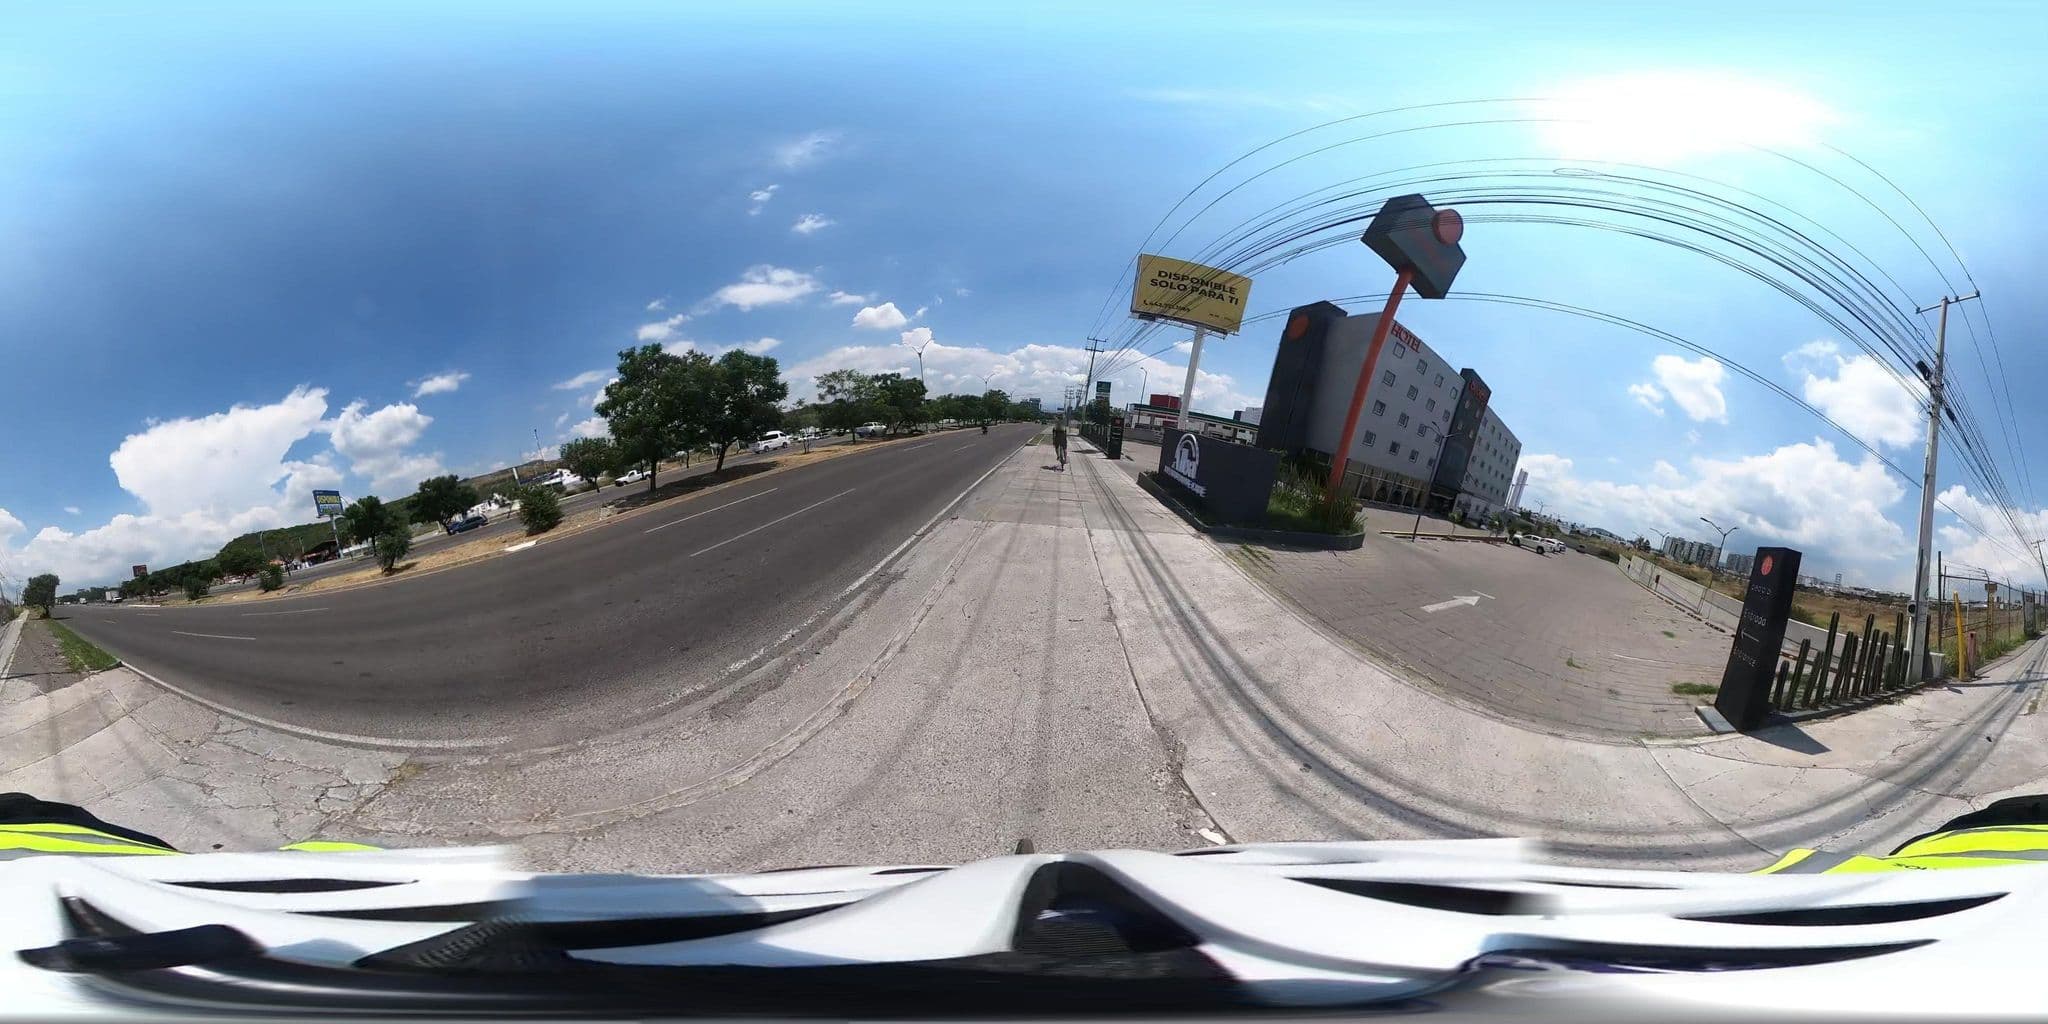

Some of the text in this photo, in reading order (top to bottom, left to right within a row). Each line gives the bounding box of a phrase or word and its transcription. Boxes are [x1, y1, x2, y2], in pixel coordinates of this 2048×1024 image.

[1150, 279, 1239, 306] SOLO PARA TI
[1157, 270, 1237, 295] DISPONIBLE
[1391, 322, 1421, 354] HOTEL
